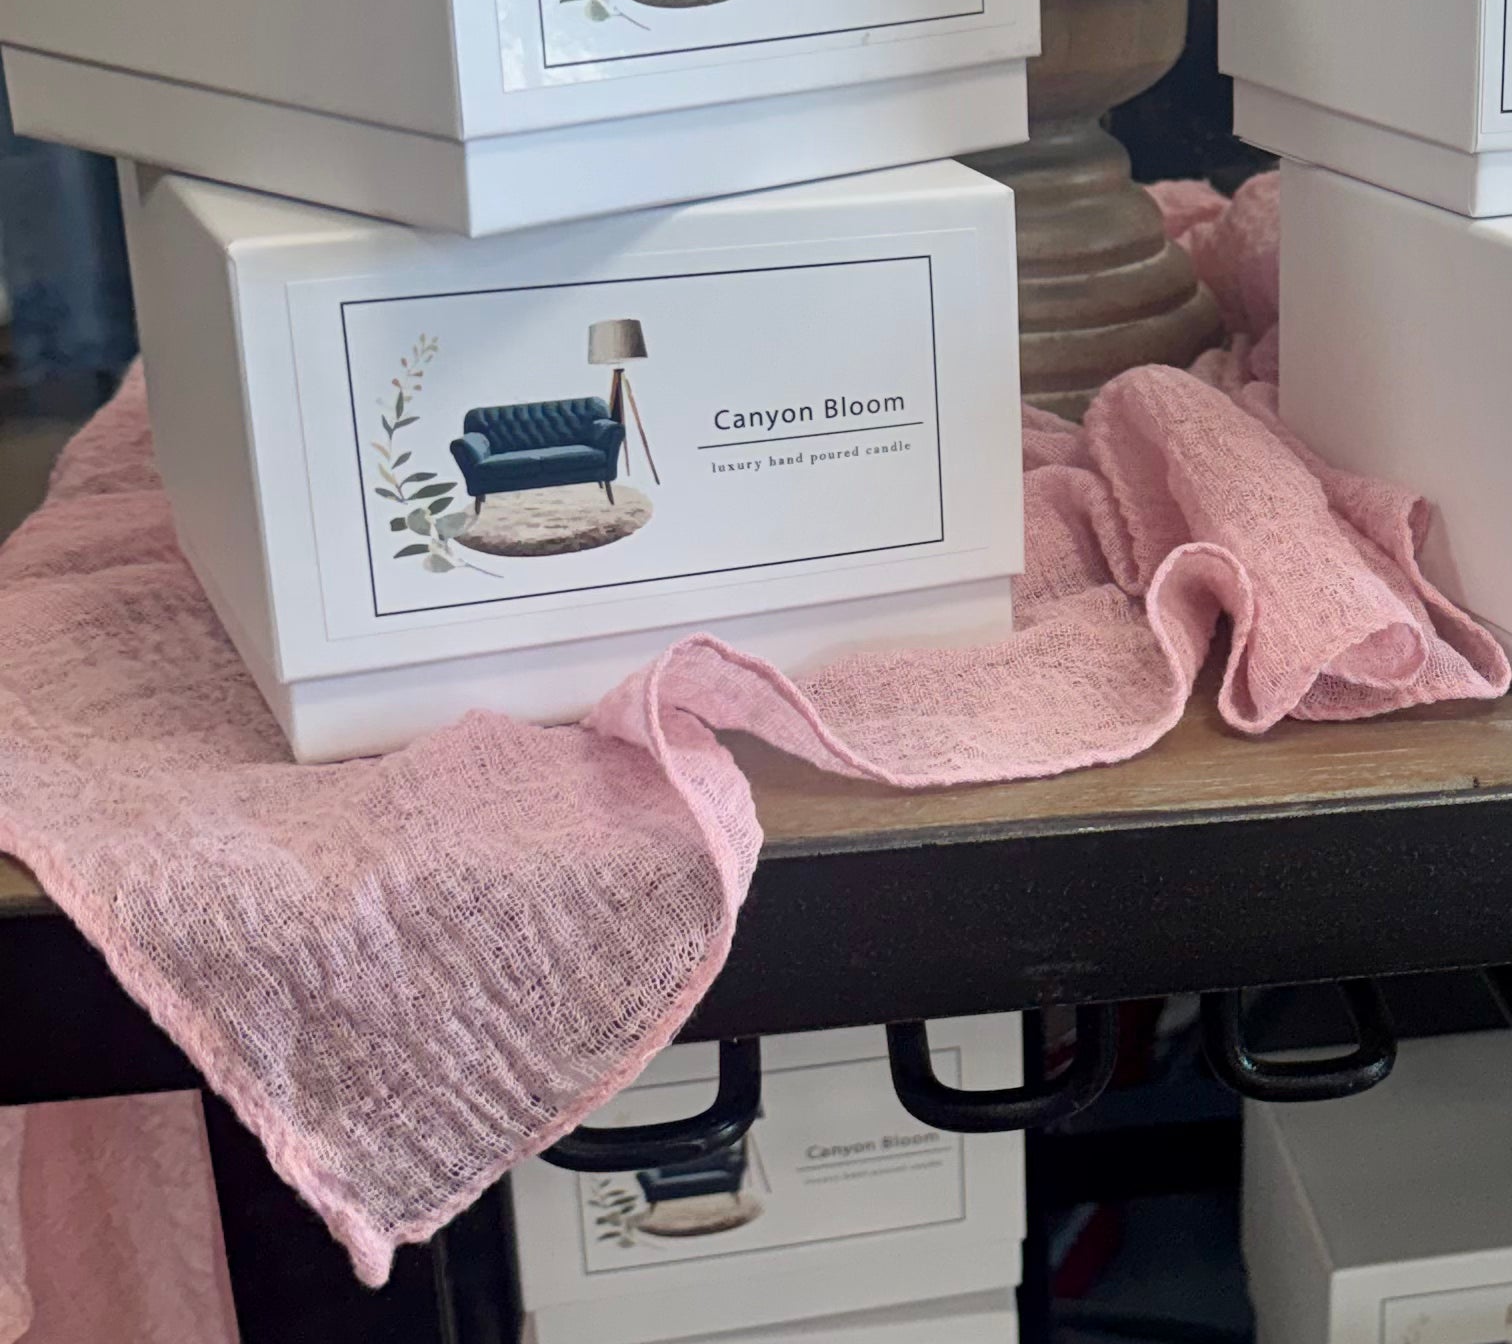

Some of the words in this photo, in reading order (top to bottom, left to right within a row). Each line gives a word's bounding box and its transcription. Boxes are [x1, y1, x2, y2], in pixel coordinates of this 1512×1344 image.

[713, 405, 814, 431] Canyon
[824, 395, 905, 419] Bloom
[711, 459, 762, 474] luxury
[769, 452, 804, 468] hand
[810, 446, 860, 465] poured
[865, 440, 912, 455] candle
[806, 1140, 876, 1159] Canyon
[882, 1132, 941, 1149] Bloom
